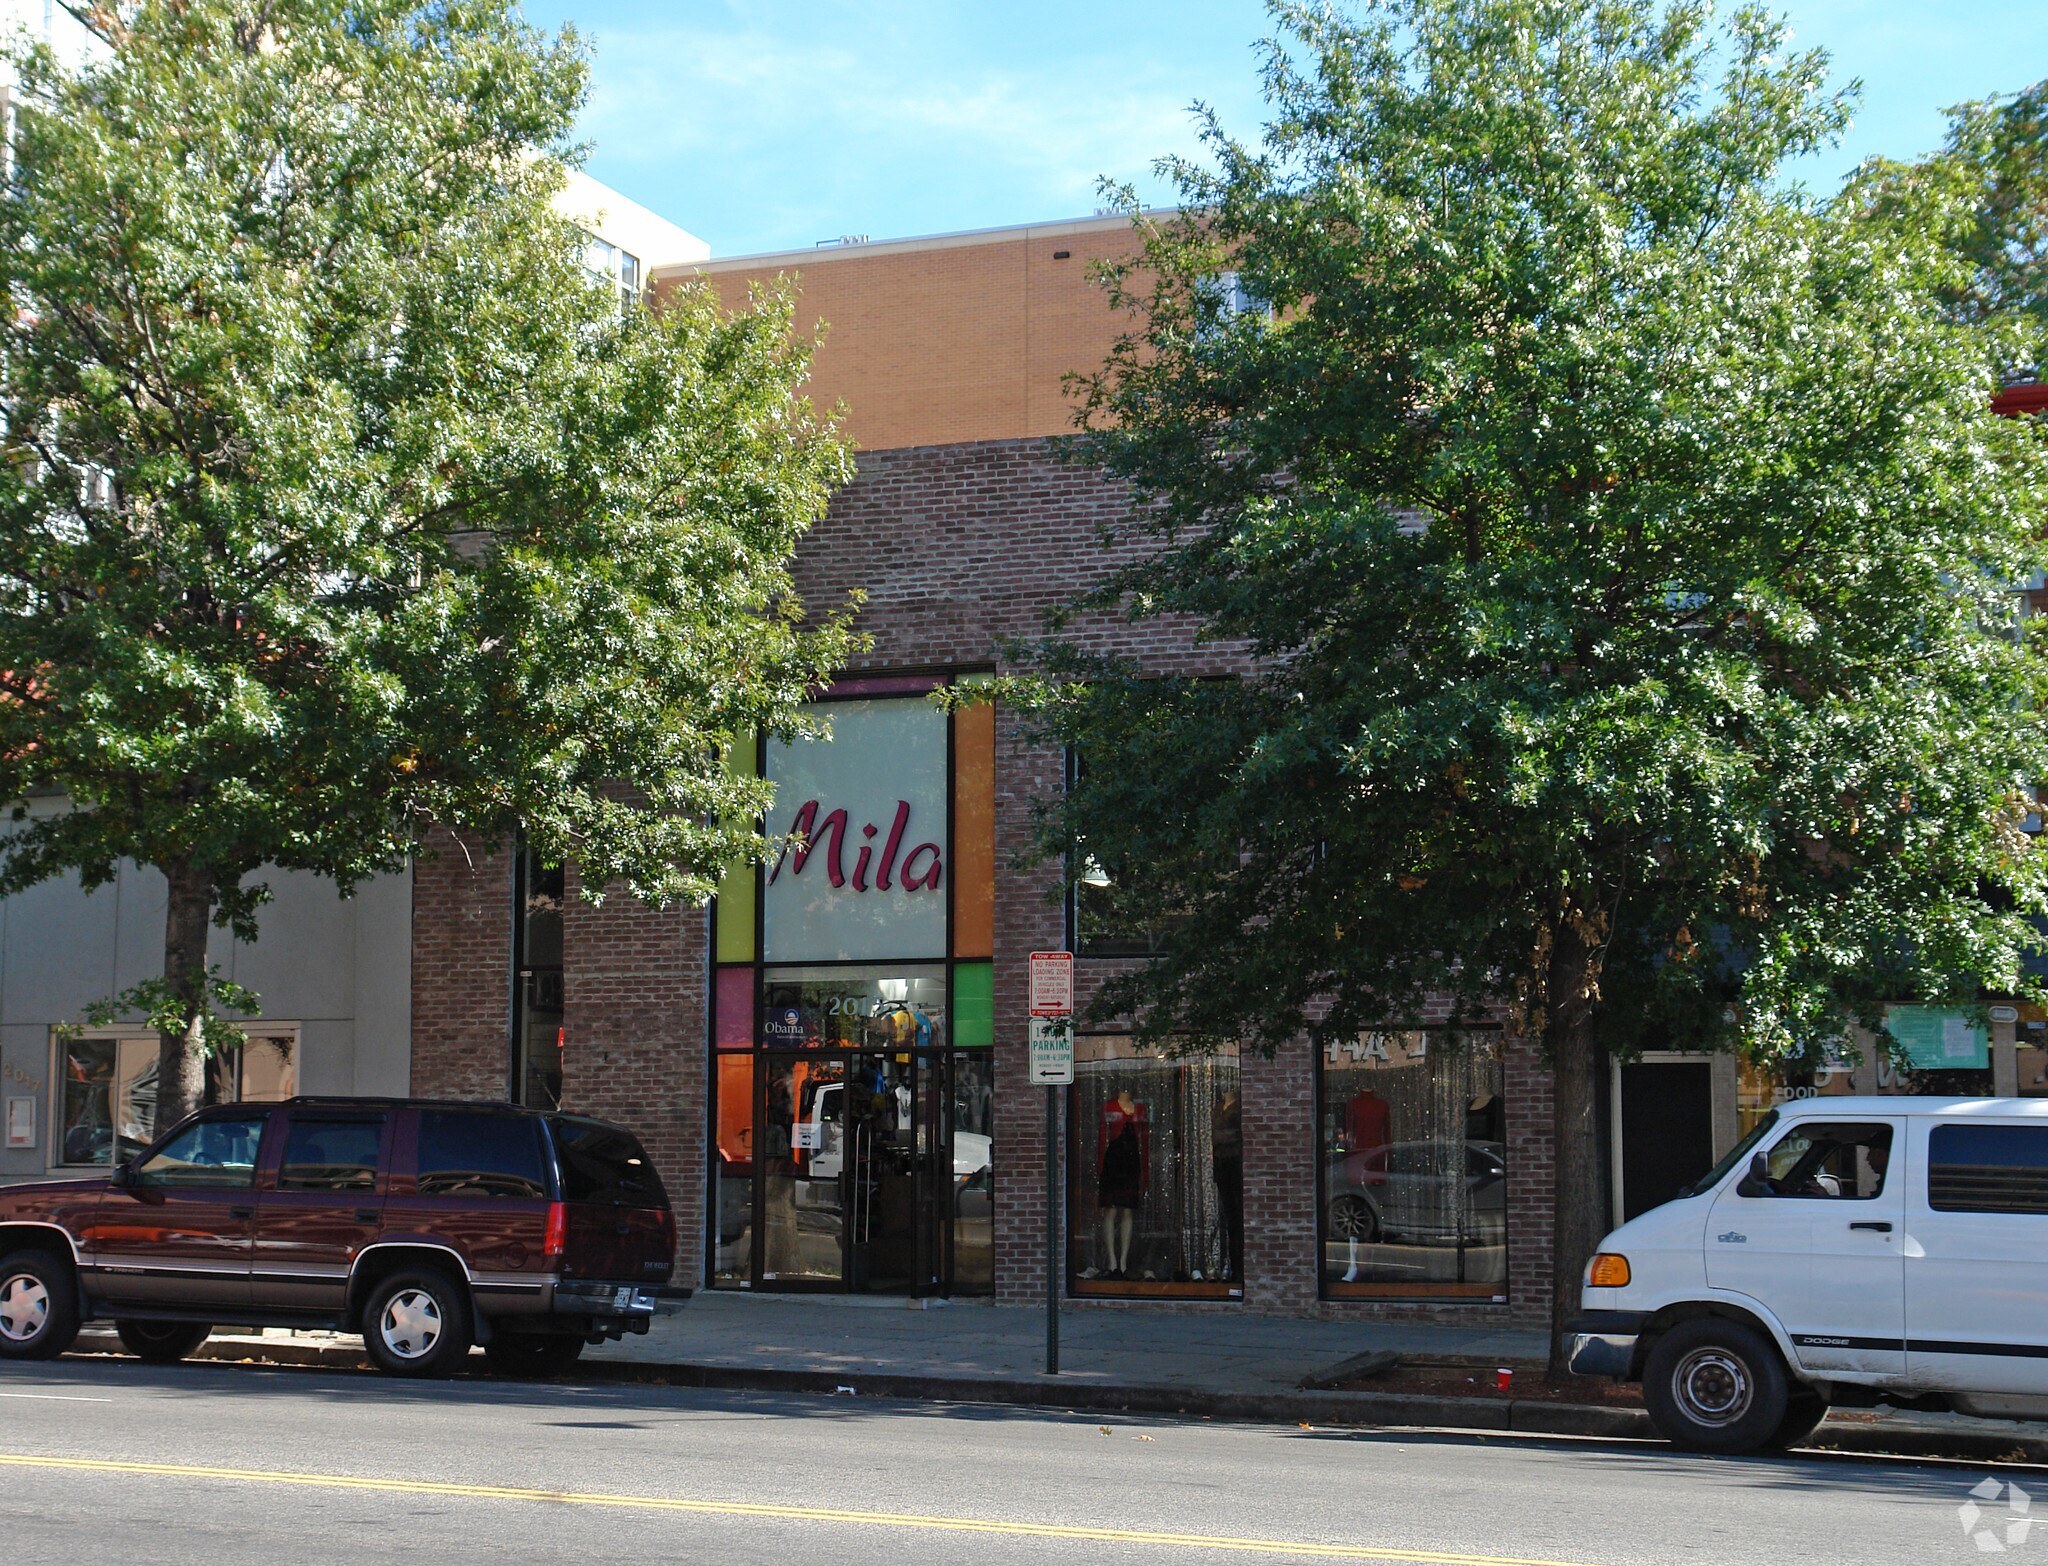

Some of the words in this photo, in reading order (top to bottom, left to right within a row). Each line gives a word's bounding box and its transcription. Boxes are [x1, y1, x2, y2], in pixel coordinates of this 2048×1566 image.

[768, 799, 941, 893] Mila
[764, 1021, 804, 1034] Obama
[1036, 1026, 1040, 1037] 1
[1033, 1040, 1070, 1051] PARKING
[1803, 1337, 1850, 1346] DODGE
